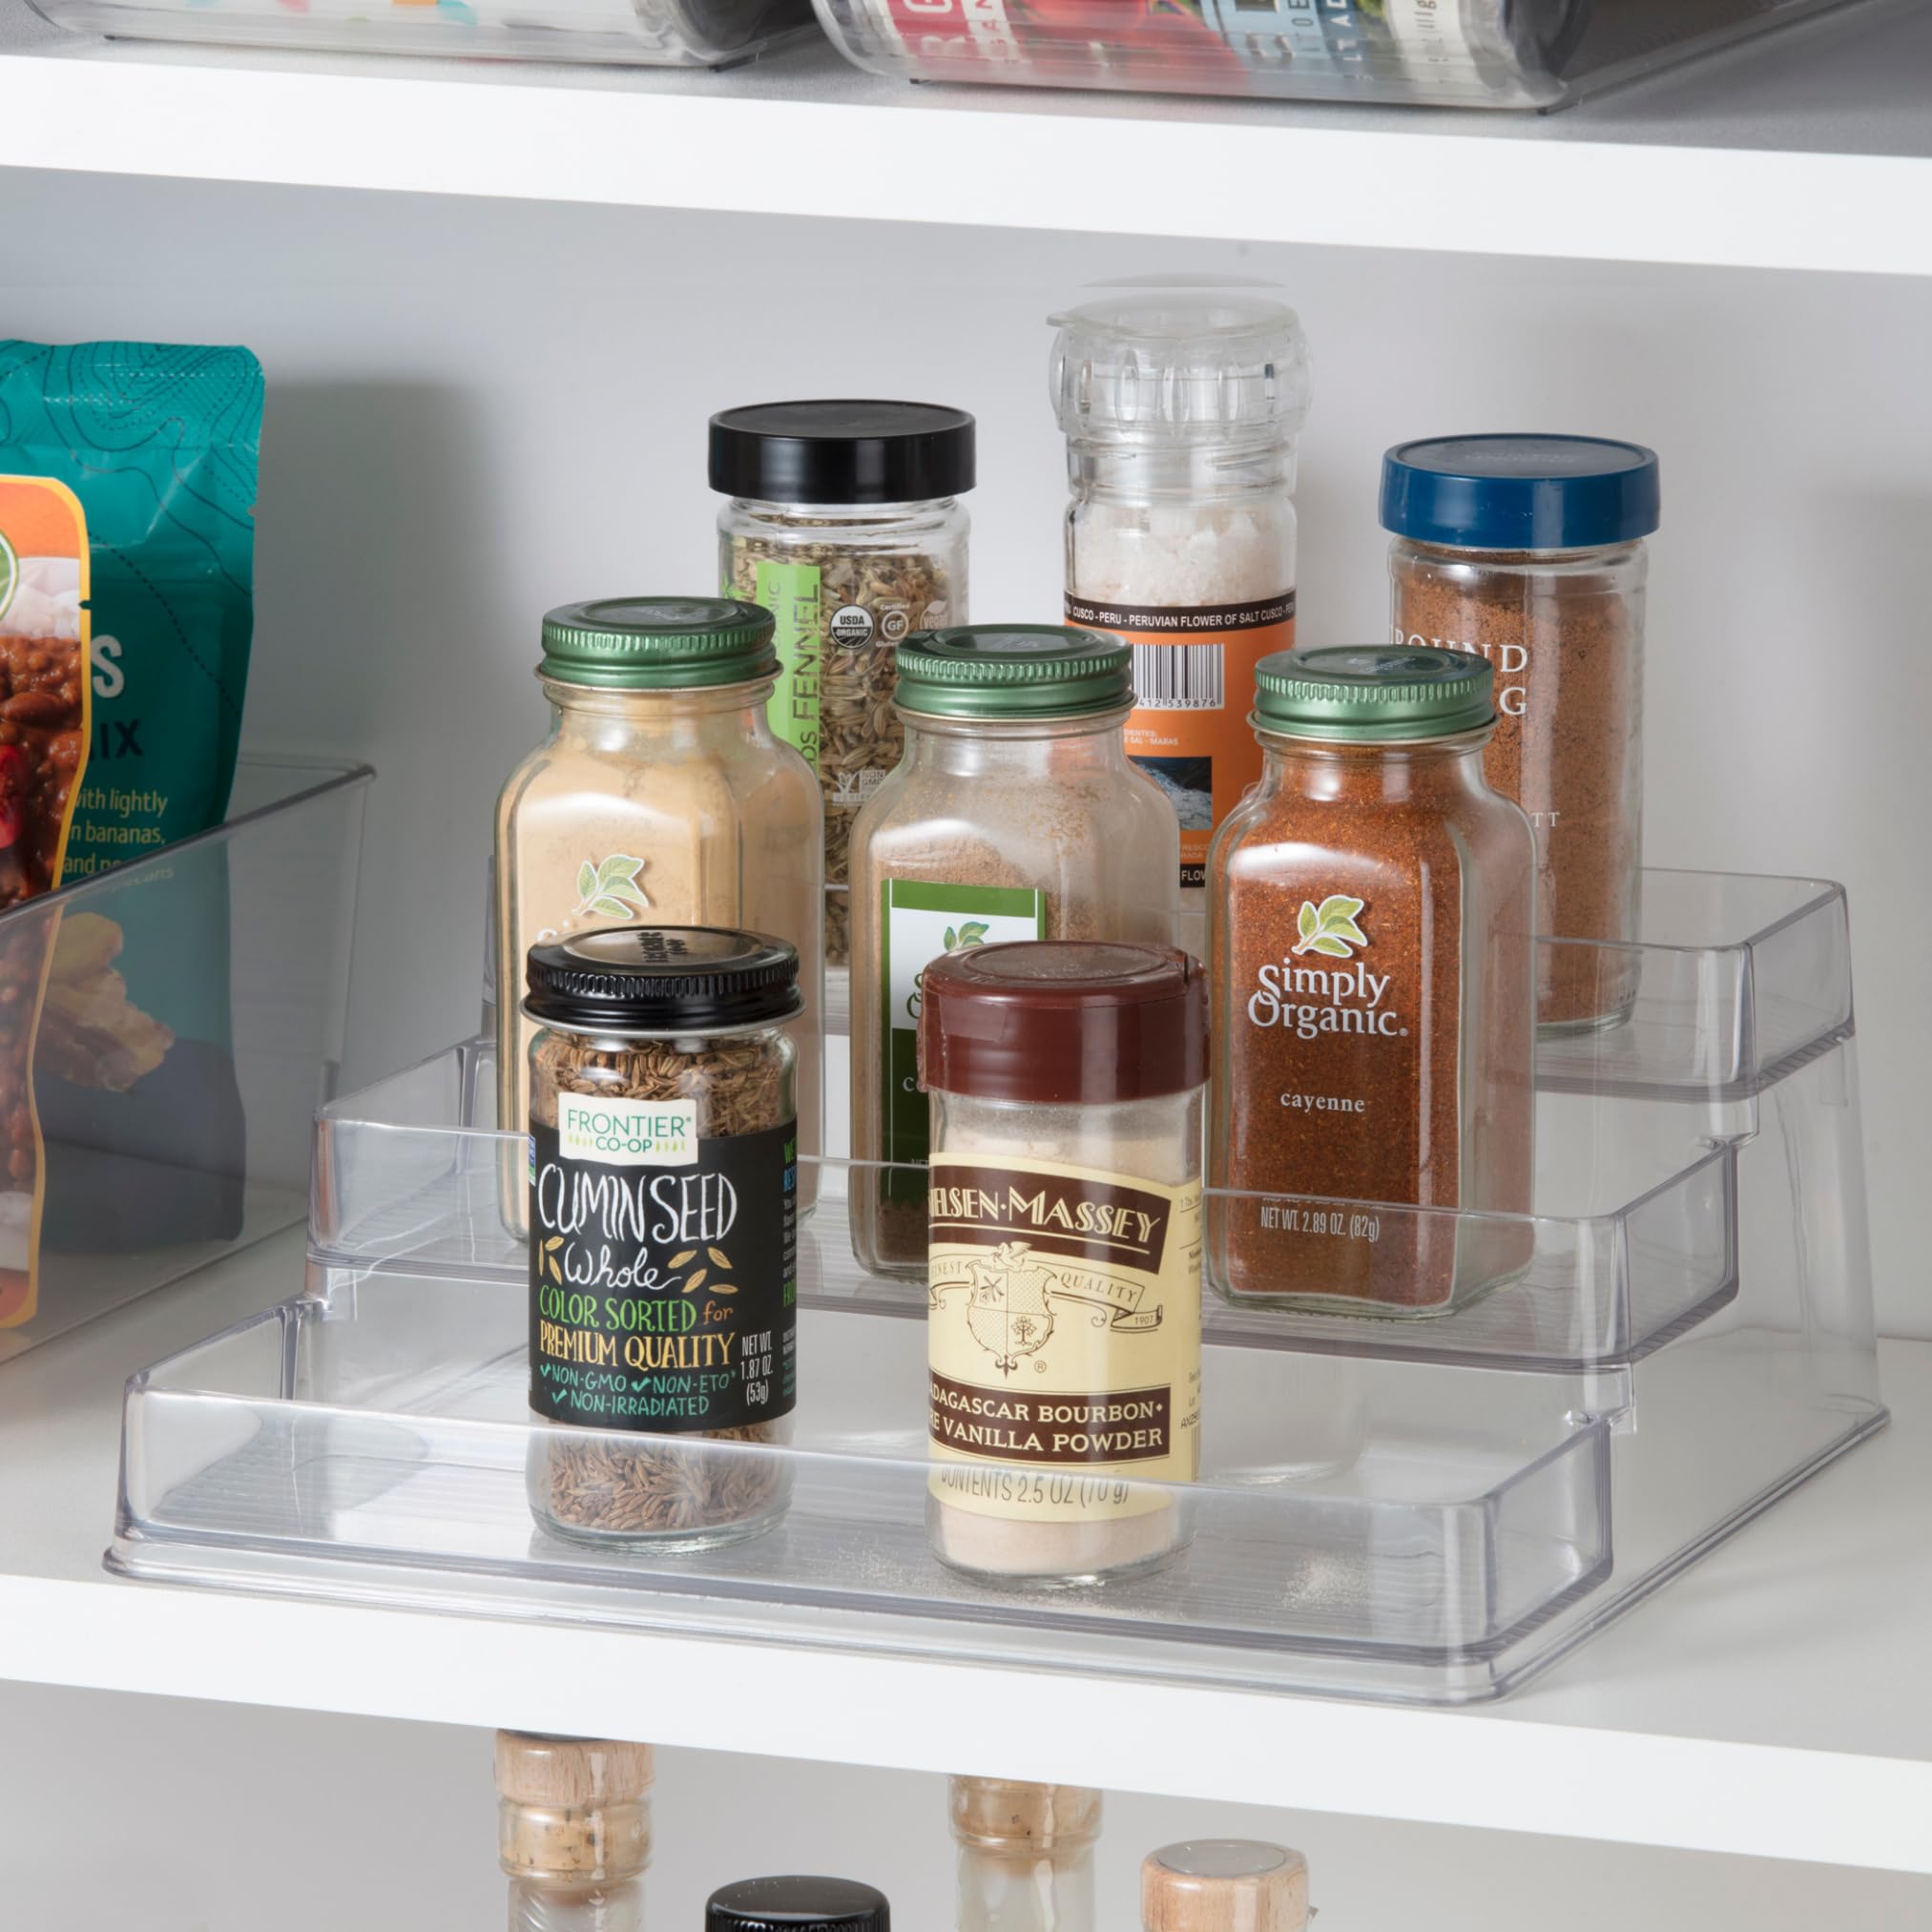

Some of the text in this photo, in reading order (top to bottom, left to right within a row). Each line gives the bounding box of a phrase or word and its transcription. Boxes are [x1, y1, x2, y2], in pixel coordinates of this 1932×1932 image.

[840, 615, 865, 626] USDA
[887, 620, 904, 631] GF
[1073, 606, 1094, 620] CUSCO
[1099, 612, 1122, 624] PERU
[1129, 614, 1178, 627] PERUVIAN
[1180, 614, 1223, 627] FLOWER
[1224, 613, 1237, 625] OF
[1239, 611, 1259, 623] SALT
[1260, 605, 1282, 620] CUSCO
[793, 583, 819, 721] FENNEL
[1168, 699, 1216, 708] 539876
[91, 718, 143, 761] IX
[110, 788, 169, 819] lightly
[86, 819, 166, 845] bananas,
[1258, 958, 1390, 1008] Simply
[1280, 1090, 1365, 1115] cayenne
[595, 1135, 654, 1153] CO-OP
[538, 1163, 647, 1242] CUMIN
[649, 1172, 737, 1242] SEED
[1260, 1206, 1279, 1230] NET
[1302, 1211, 1327, 1235] 2.89
[1330, 1213, 1346, 1236] OZ.
[1350, 1214, 1381, 1243] (82g)
[564, 1242, 683, 1290] Whole
[1060, 1272, 1137, 1303] QUALITY
[540, 1285, 734, 1334] COLOR SORTED for
[1134, 1316, 1153, 1326] 1907
[540, 1319, 618, 1367] PREMIUM
[624, 1332, 736, 1372] QUALITY
[742, 1334, 759, 1357] NET
[552, 1364, 627, 1393] NON-GMO
[740, 1357, 760, 1381] 1.87
[571, 1390, 710, 1418] NON-IRRADIATED
[746, 1381, 769, 1406] (53g)
[943, 1416, 1044, 1452] VANILLA
[1052, 1428, 1163, 1453] POWDER
[1017, 1474, 1044, 1505] 2.5
